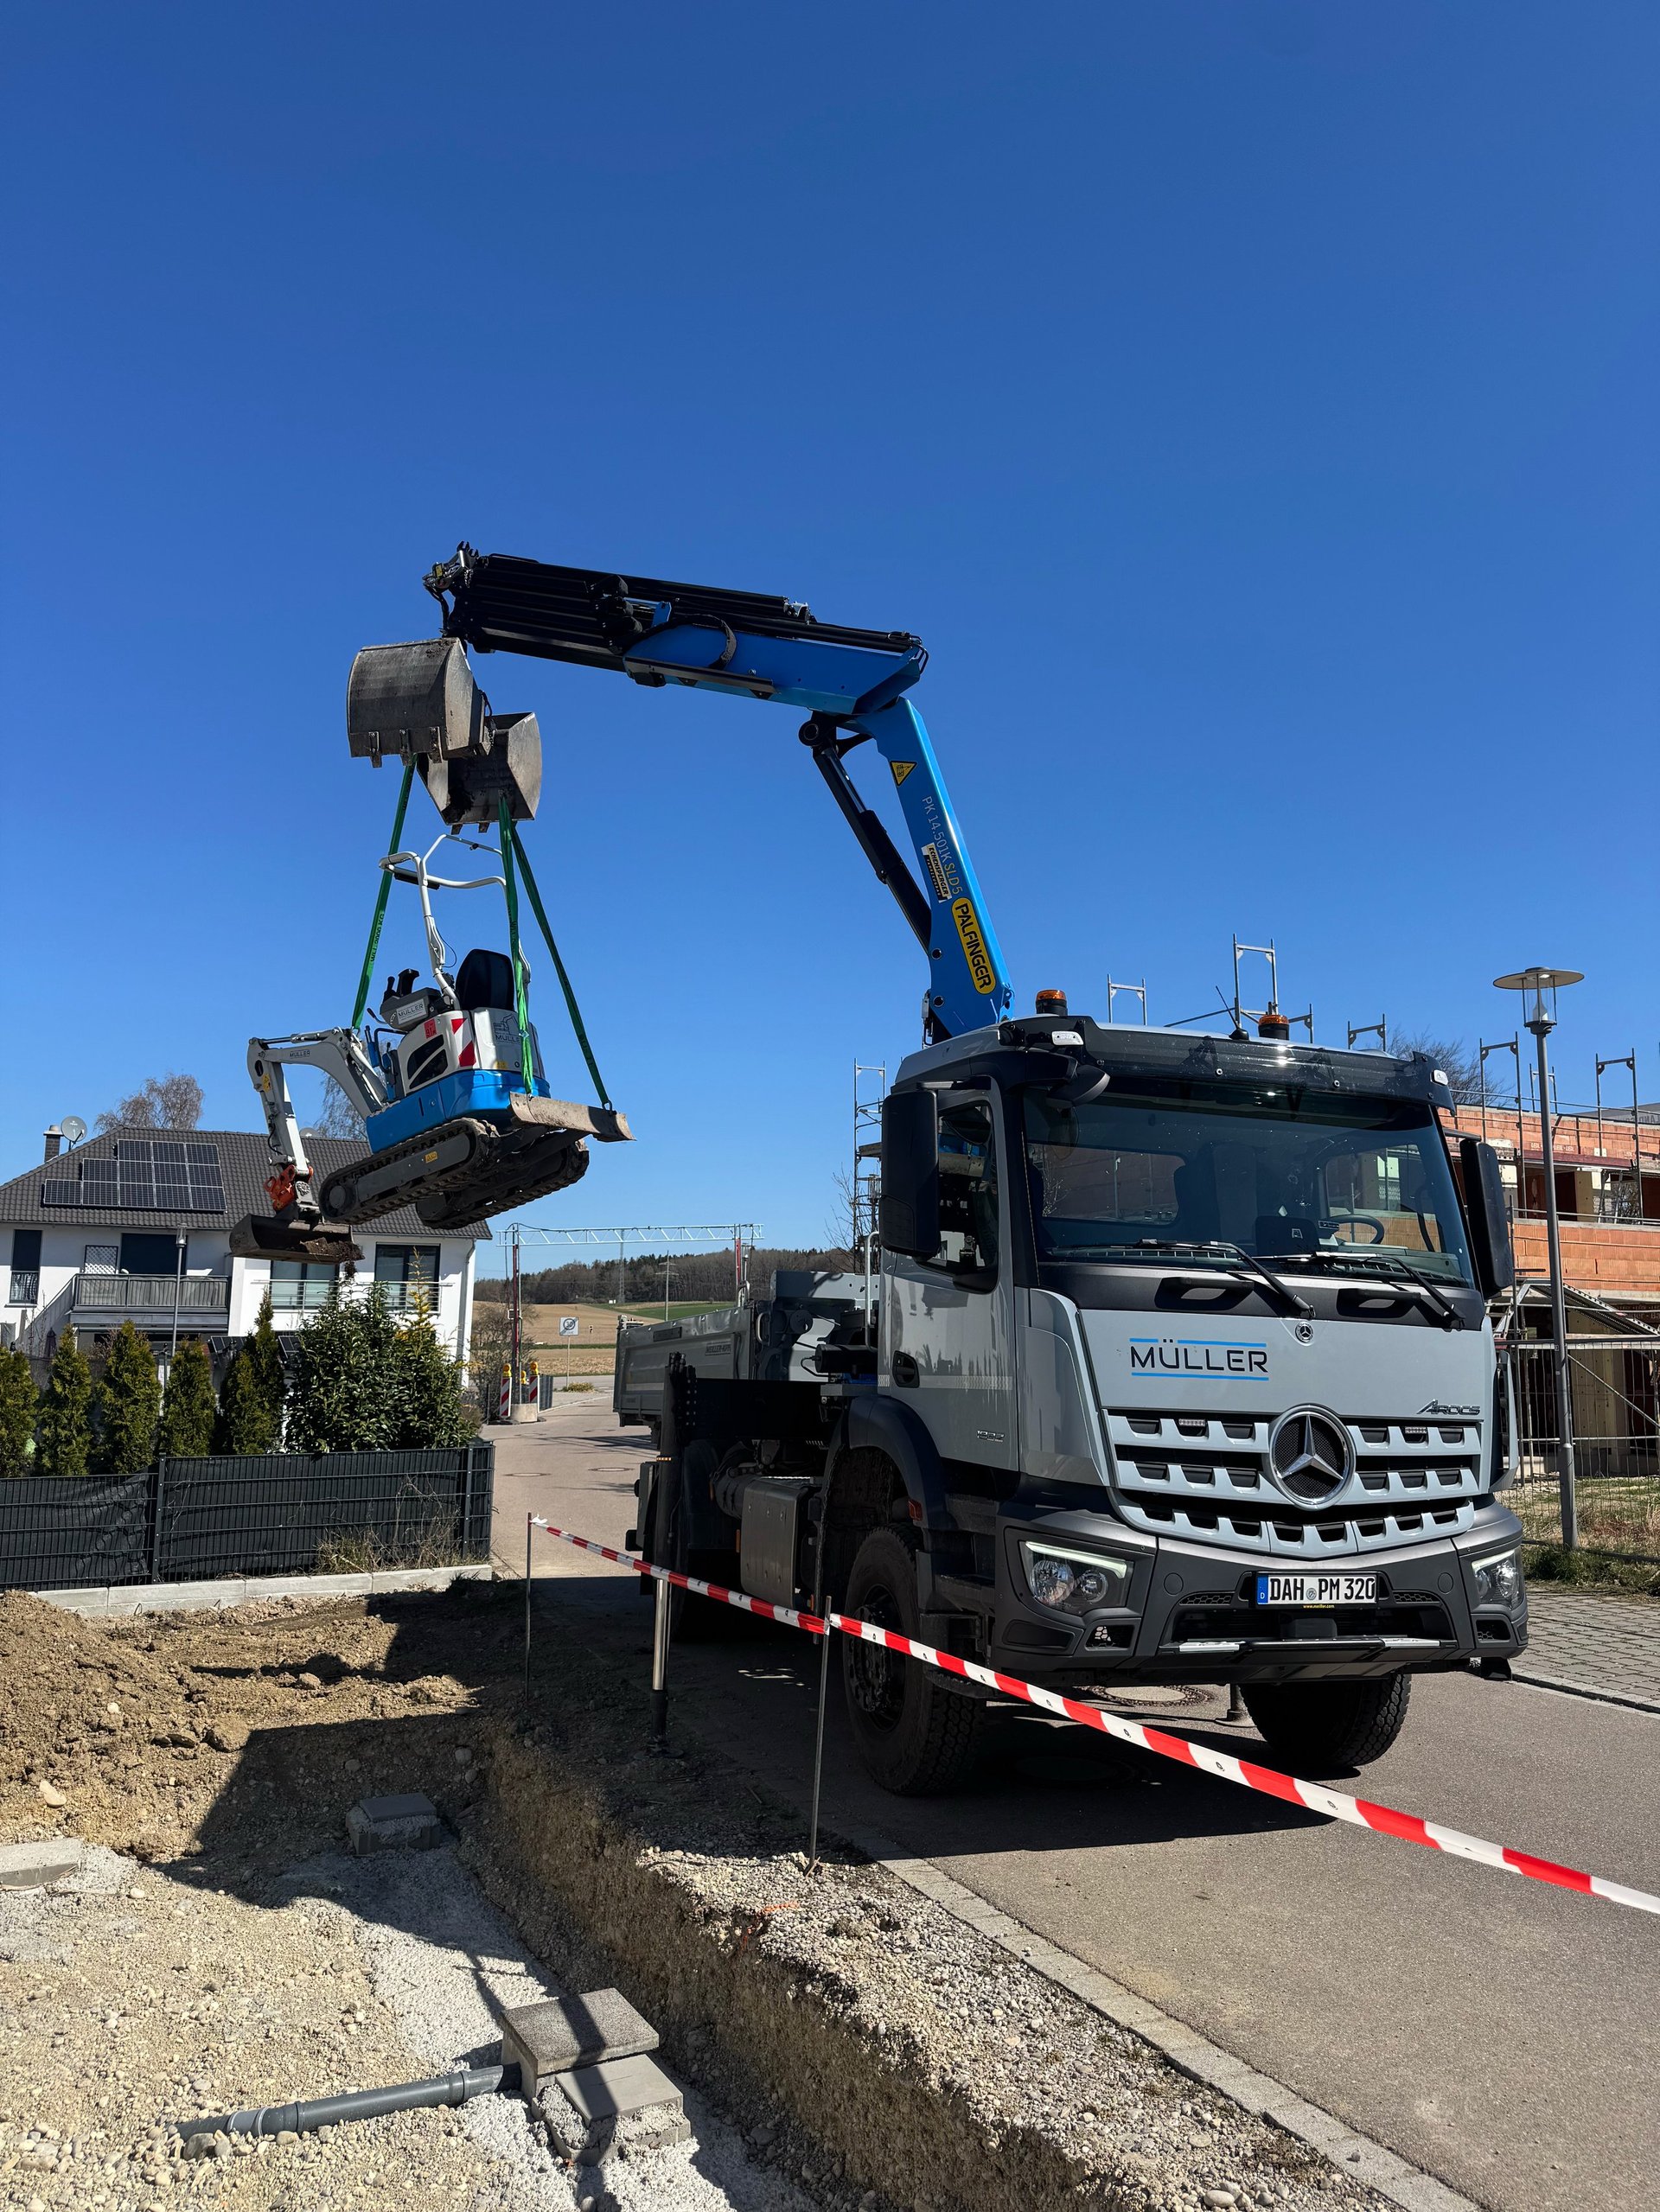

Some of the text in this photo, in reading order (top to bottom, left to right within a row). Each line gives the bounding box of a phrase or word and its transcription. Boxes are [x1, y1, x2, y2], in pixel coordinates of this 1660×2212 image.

[923, 796, 935, 814] PK
[928, 815, 952, 863] 14.501K
[955, 903, 992, 989] PALFINGER
[1131, 1339, 1268, 1373] MÜLLER
[1269, 1578, 1376, 1600] DAH PM 320
